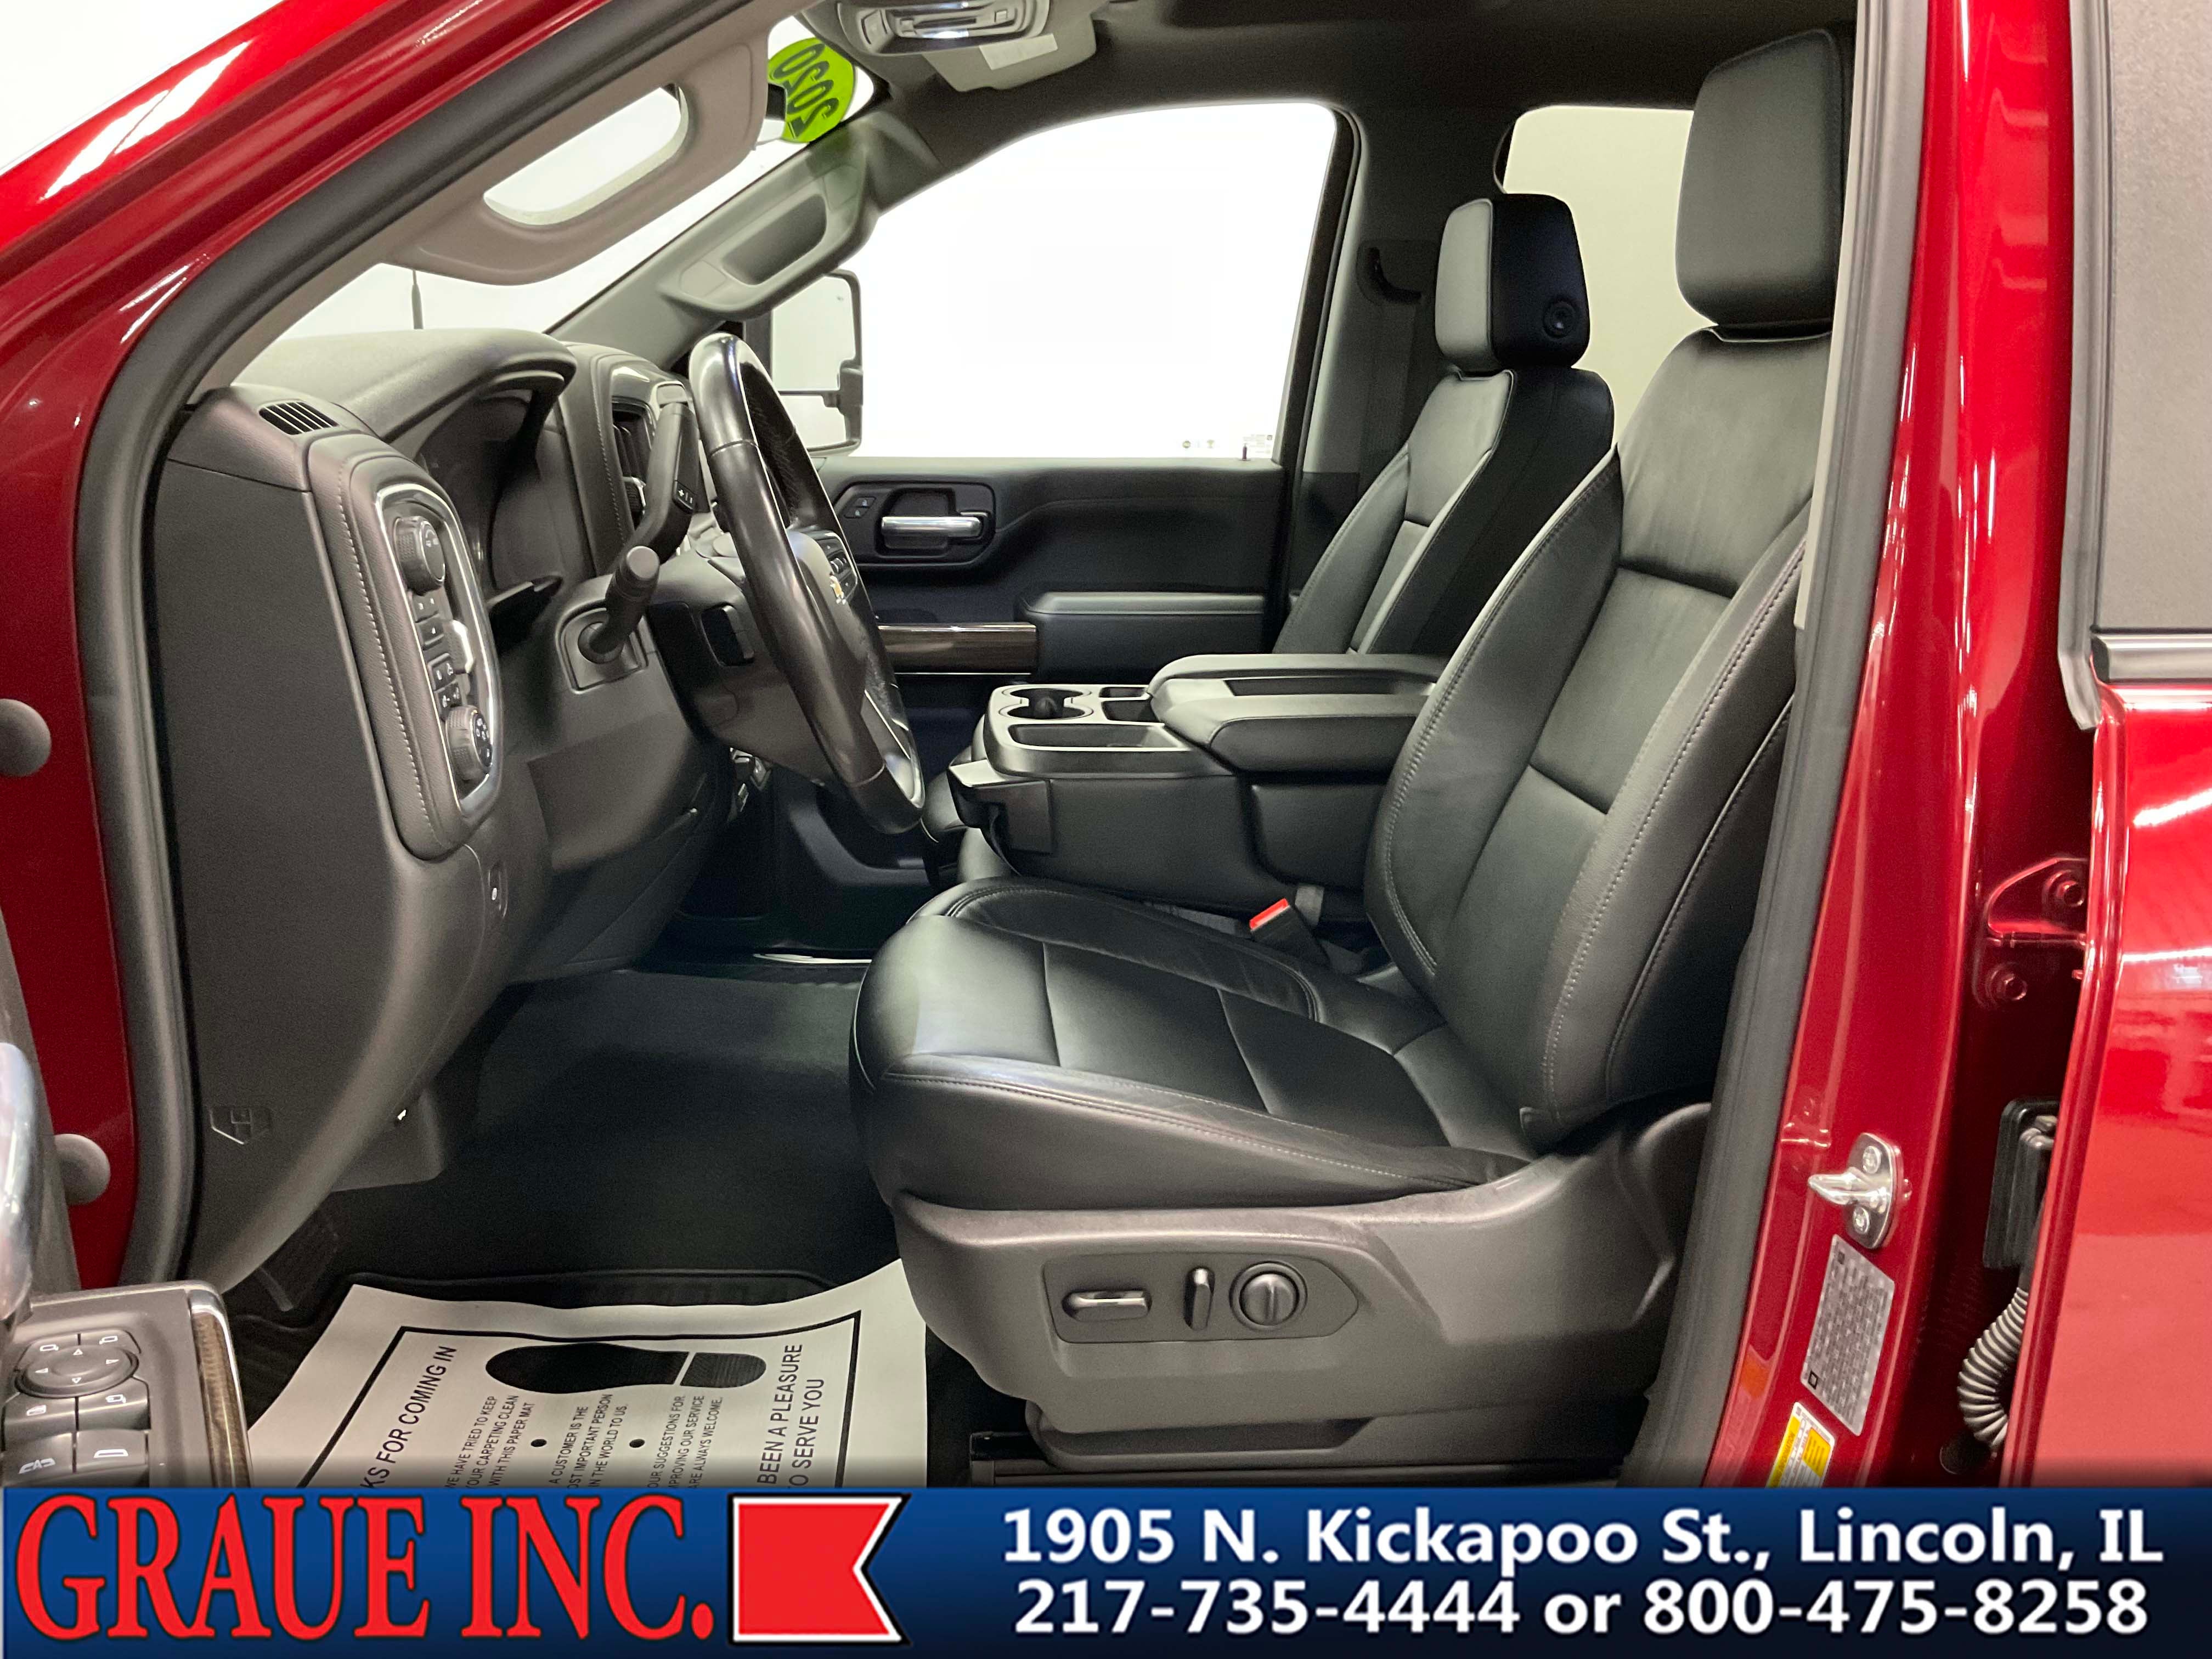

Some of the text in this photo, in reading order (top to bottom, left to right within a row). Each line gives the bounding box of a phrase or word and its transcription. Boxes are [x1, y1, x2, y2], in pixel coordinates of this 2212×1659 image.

[376, 1429, 413, 1464] FOR
[398, 1364, 447, 1424] COMING
[433, 1346, 457, 1362] IN
[480, 1396, 497, 1415] KEEP
[802, 1379, 825, 1411] YOU
[474, 1417, 488, 1426] TO
[610, 1418, 623, 1427] TO
[686, 1396, 704, 1427] SERVICE
[757, 1344, 803, 1485] BEEN A PLEASURE
[462, 1429, 482, 1451] TRIED
[466, 1395, 519, 1488] OUR CARPETING CLEAN
[487, 1402, 535, 1486] WITH THIS PAPER MAT
[551, 1432, 579, 1476] CUSTOMER
[573, 1407, 589, 1421] THE
[573, 1426, 601, 1471] IMPORTANT
[591, 1394, 613, 1424] PERSON
[598, 1430, 618, 1459] WORLD
[654, 1413, 680, 1469] SUGGESTIONS
[671, 1396, 686, 1412] FOR
[680, 1429, 695, 1446] OUR
[792, 1415, 819, 1469] SERVE
[450, 1454, 471, 1475] HAVE
[591, 1462, 608, 1477] THE
[693, 1439, 712, 1471] ALWAYS
